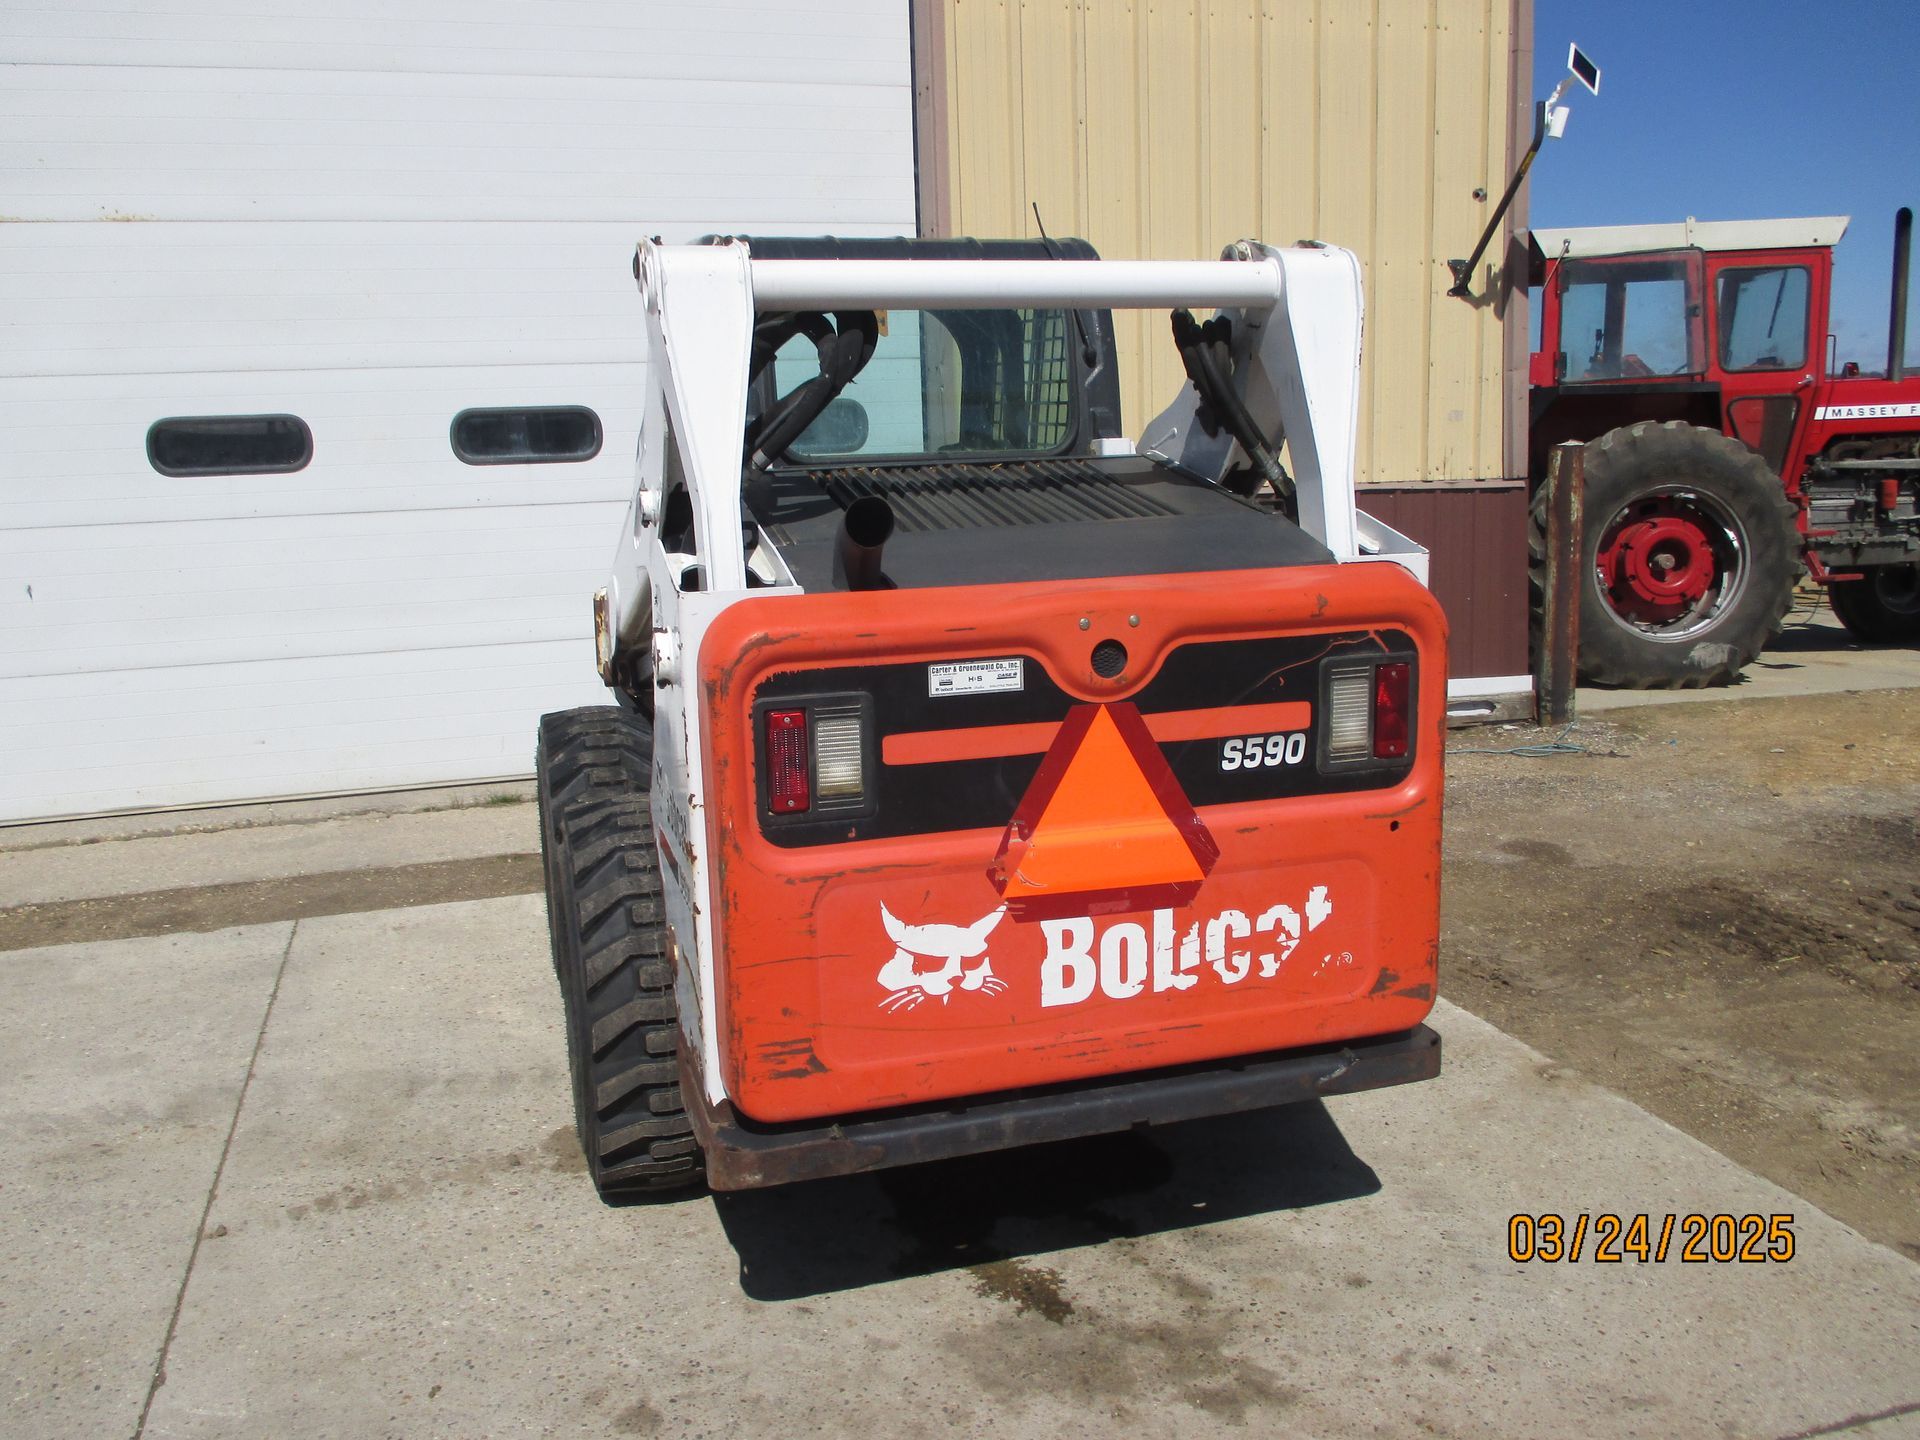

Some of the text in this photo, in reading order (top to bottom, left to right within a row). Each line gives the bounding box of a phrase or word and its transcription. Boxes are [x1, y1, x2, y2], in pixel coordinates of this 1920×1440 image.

[1832, 406, 1898, 417] MASSEY
[931, 665, 951, 674] Carter
[1221, 732, 1306, 771] S590
